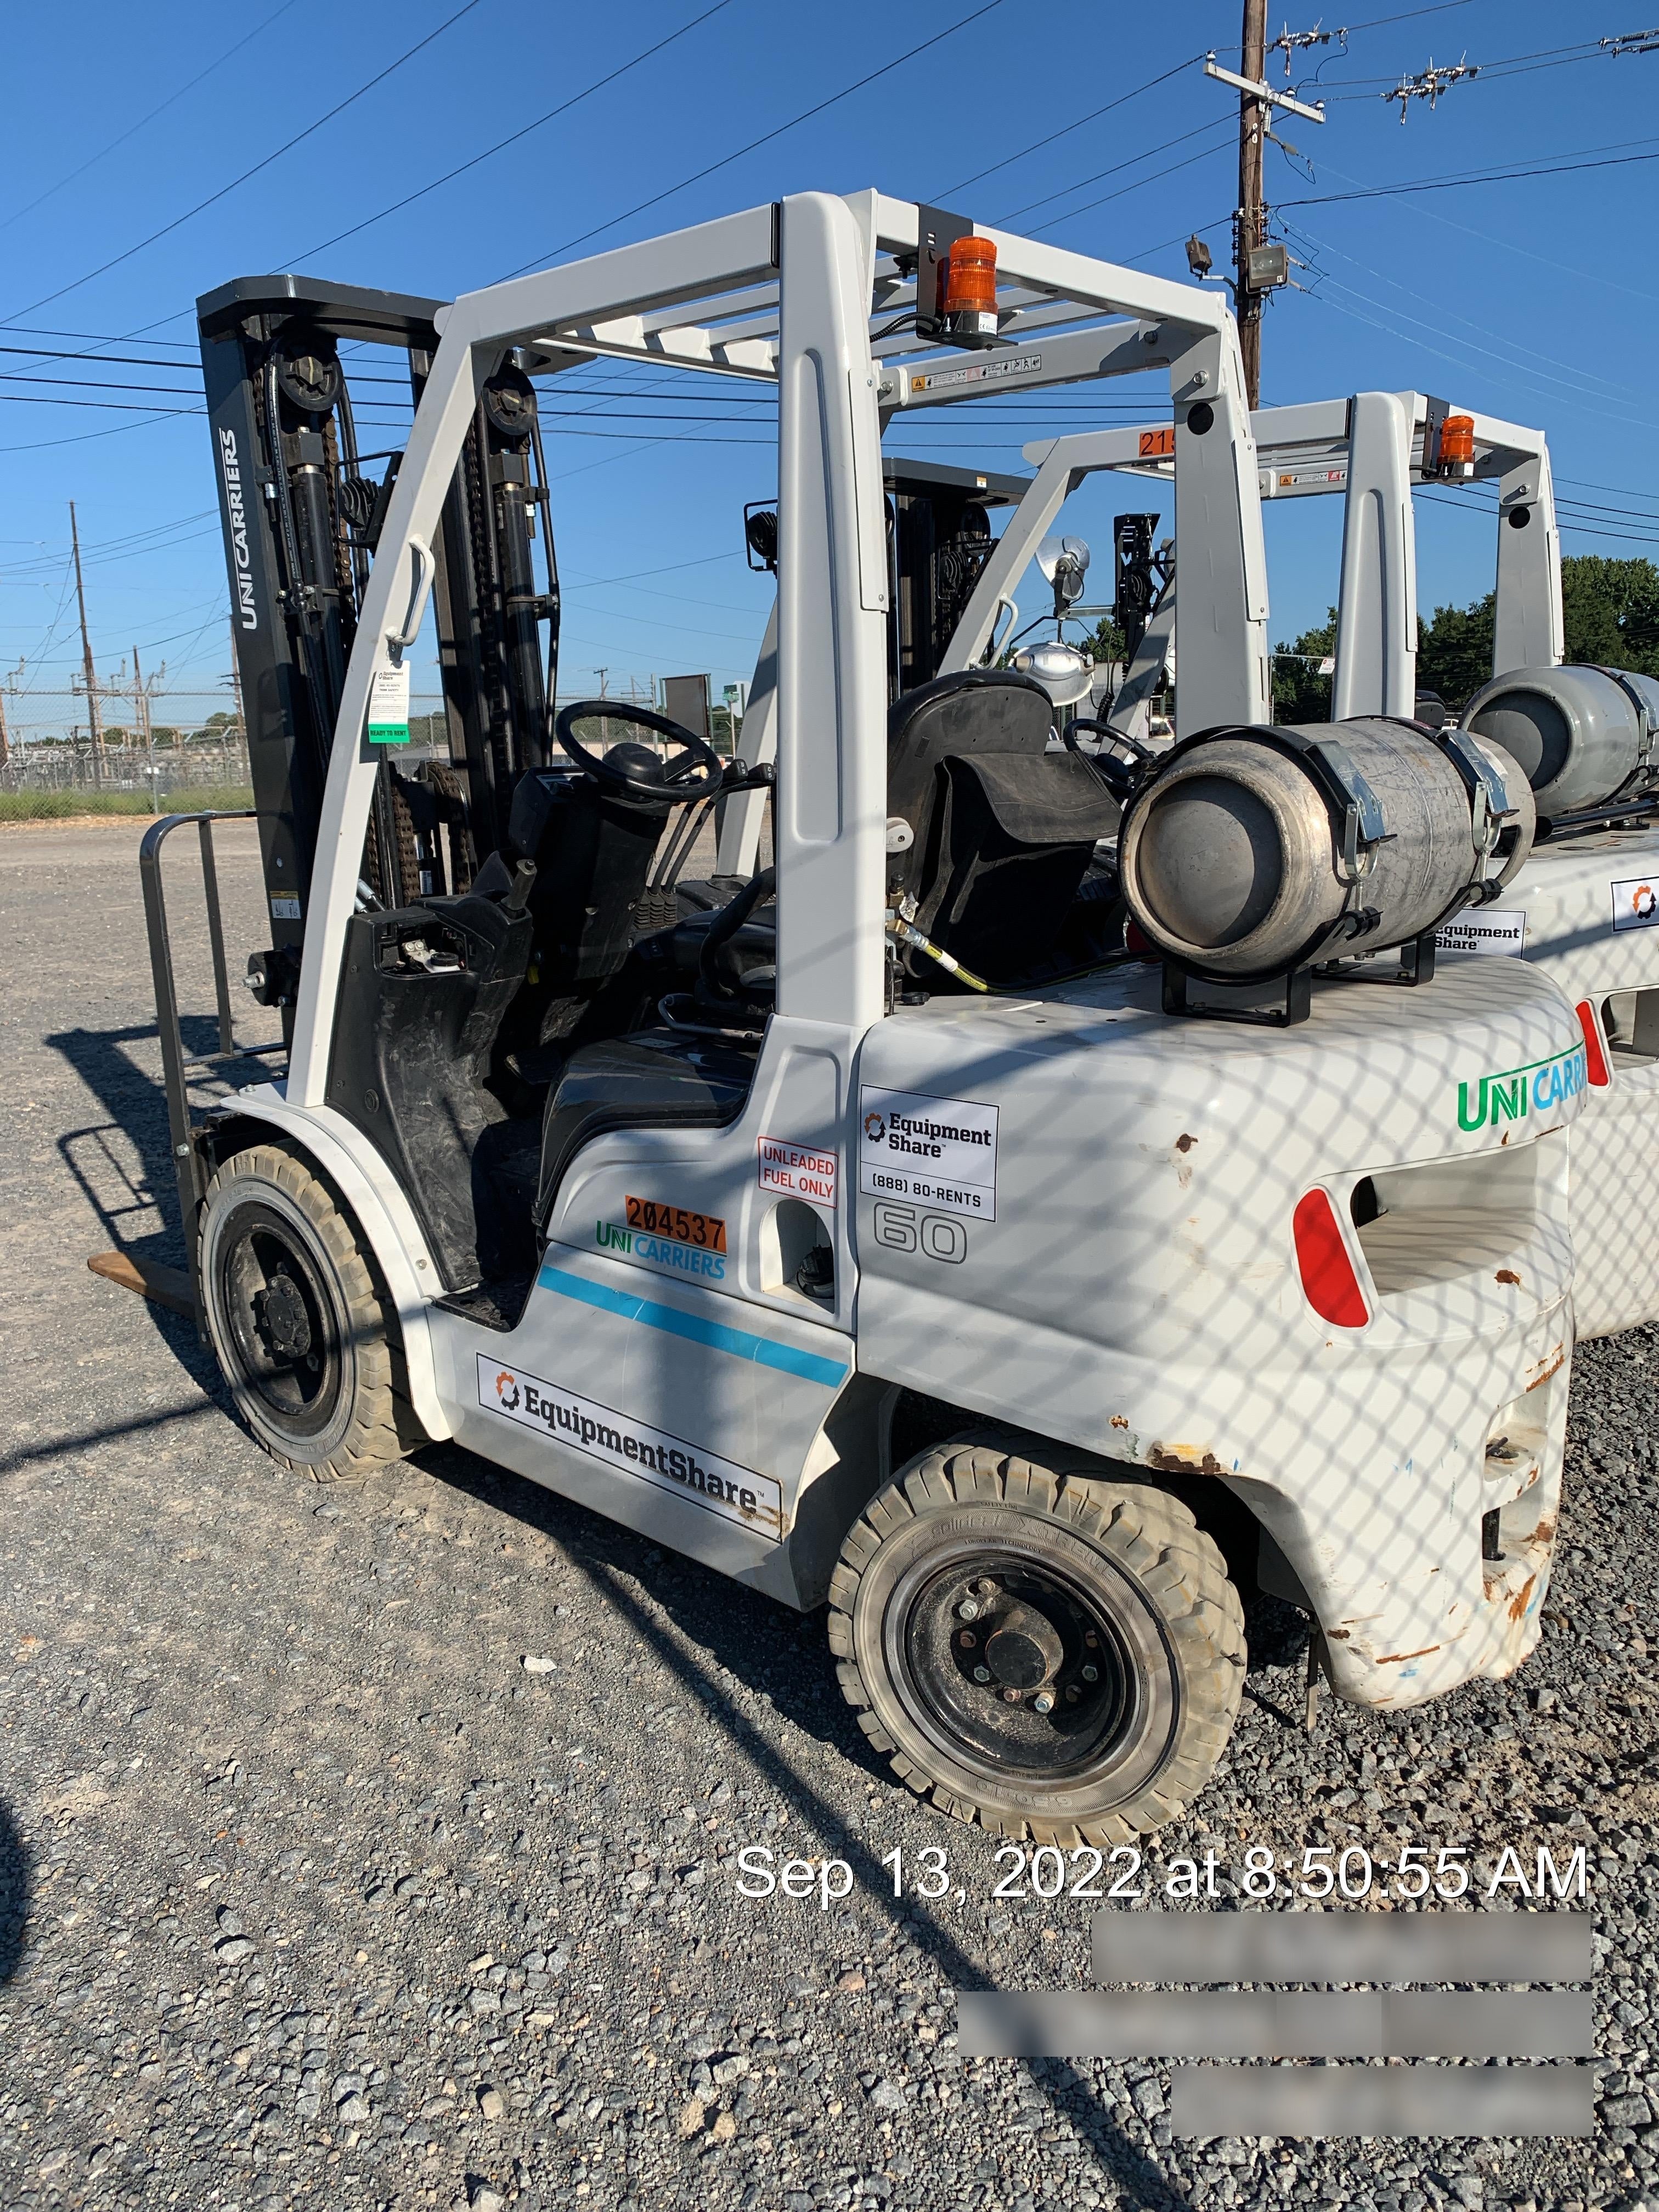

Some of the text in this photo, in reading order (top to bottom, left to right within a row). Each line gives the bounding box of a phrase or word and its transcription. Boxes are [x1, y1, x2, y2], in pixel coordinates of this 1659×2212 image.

[889, 1113, 991, 1146] Equipment
[764, 1146, 834, 1176] UNLEADED
[764, 1167, 833, 1198] FUEL ONLY
[873, 1173, 981, 1207] (888) 80-RENTS
[628, 1198, 724, 1249] 204537
[873, 1202, 967, 1265] 60
